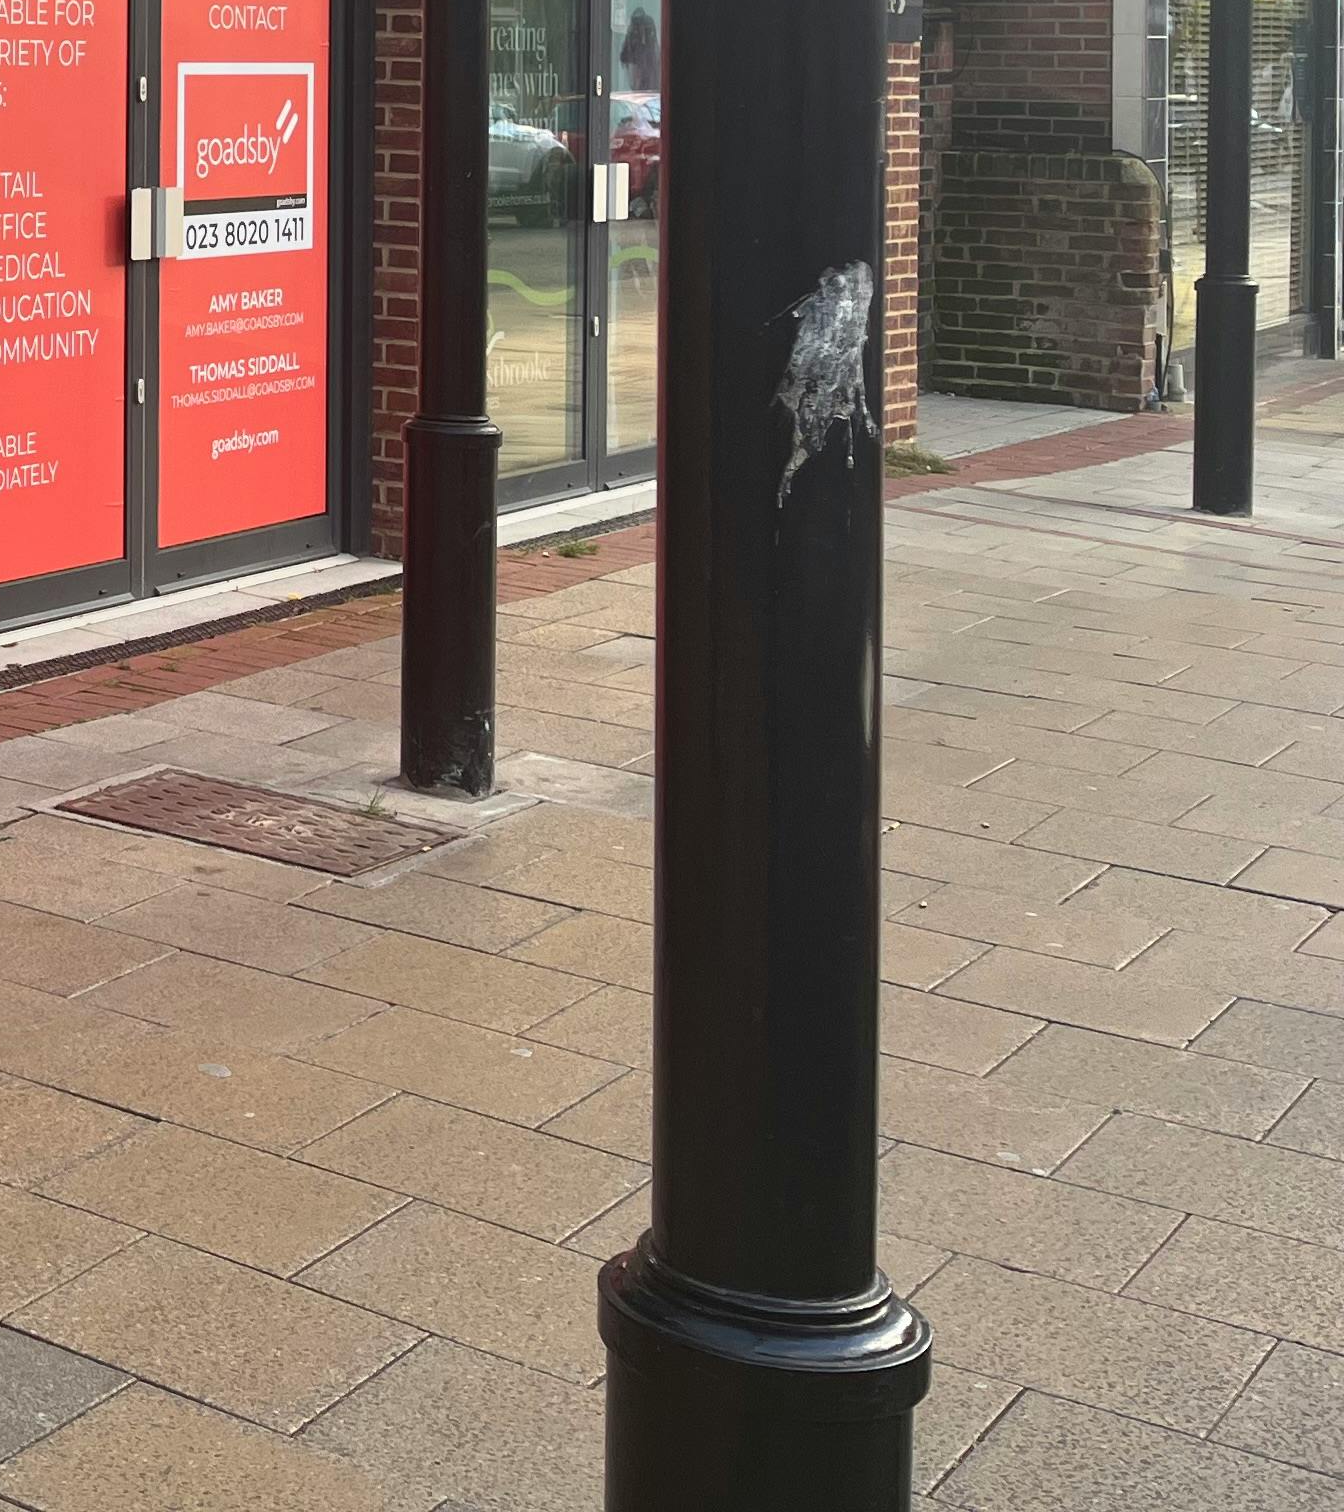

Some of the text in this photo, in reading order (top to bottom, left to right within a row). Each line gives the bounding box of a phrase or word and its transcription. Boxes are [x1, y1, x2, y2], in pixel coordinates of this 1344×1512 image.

[55, 0, 94, 26] FOR
[209, 5, 288, 30] CONTACT
[59, 40, 87, 66] OF
[490, 18, 546, 62] reating
[489, 63, 559, 97] mes with
[196, 124, 280, 178] goadsby
[186, 217, 304, 250] 023 8020 1411
[209, 288, 283, 313] AMY BAKER
[189, 352, 300, 384] THOMAS SIDDALL
[487, 351, 551, 388] stbrooke
[212, 429, 279, 460] goadsby.com
